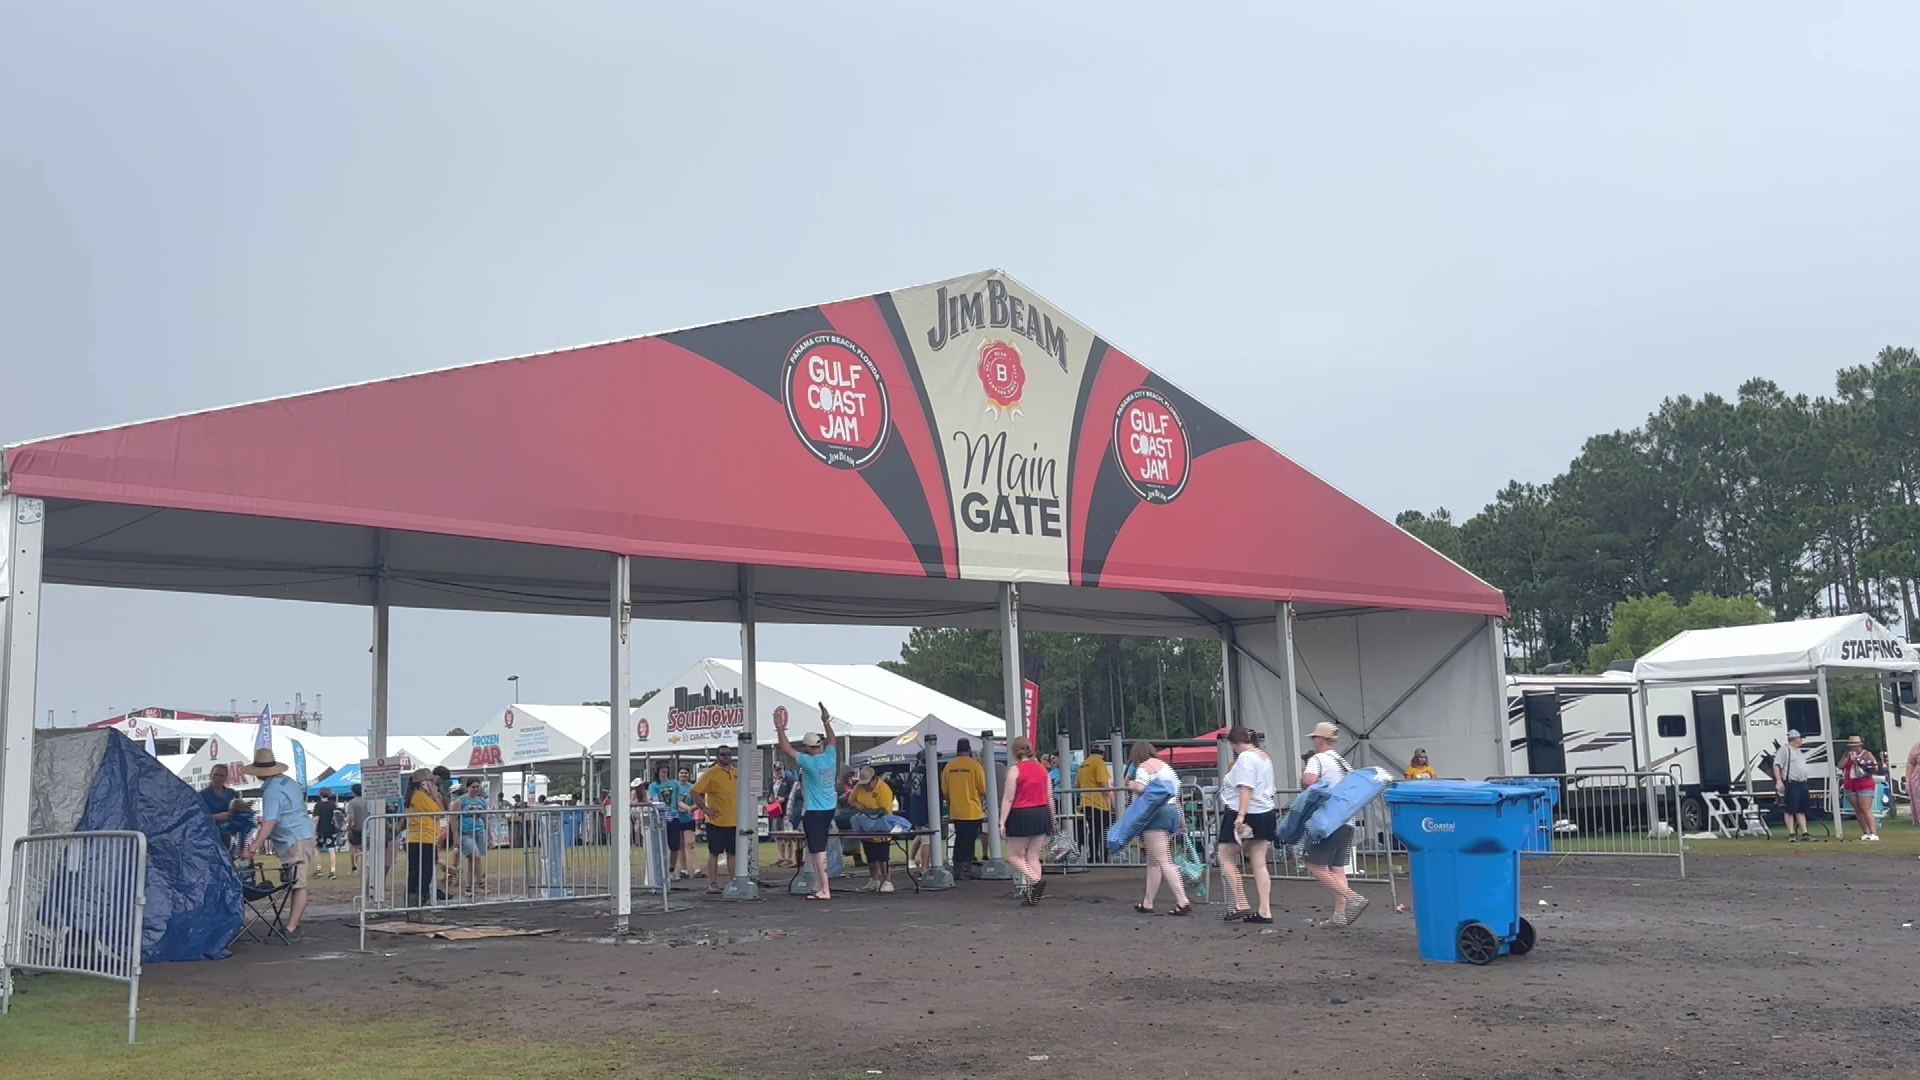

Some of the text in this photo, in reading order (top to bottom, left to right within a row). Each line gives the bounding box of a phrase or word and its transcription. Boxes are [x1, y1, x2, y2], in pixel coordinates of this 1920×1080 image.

[927, 279, 1069, 374] JIM BEAM
[789, 335, 880, 381] PANAMA CITY BEACH, FLORIDA
[808, 355, 862, 389] GULF
[996, 363, 1008, 382] B
[807, 384, 867, 417] COAST
[1116, 394, 1135, 416] PANAMA
[1134, 390, 1146, 398] CITY
[1164, 401, 1182, 427] FLORIDA
[819, 414, 859, 442] JAM
[1130, 408, 1169, 435] GULF
[1130, 433, 1173, 459] COAST
[953, 431, 1059, 500] Main
[1140, 457, 1169, 481] JAM
[960, 491, 1062, 538] GATE
[1841, 639, 1904, 661] STAFFING
[1750, 719, 1783, 727] OUTBACK
[472, 734, 500, 746] FROZEN
[467, 745, 505, 768] BAR
[1427, 821, 1456, 829] Coastal
